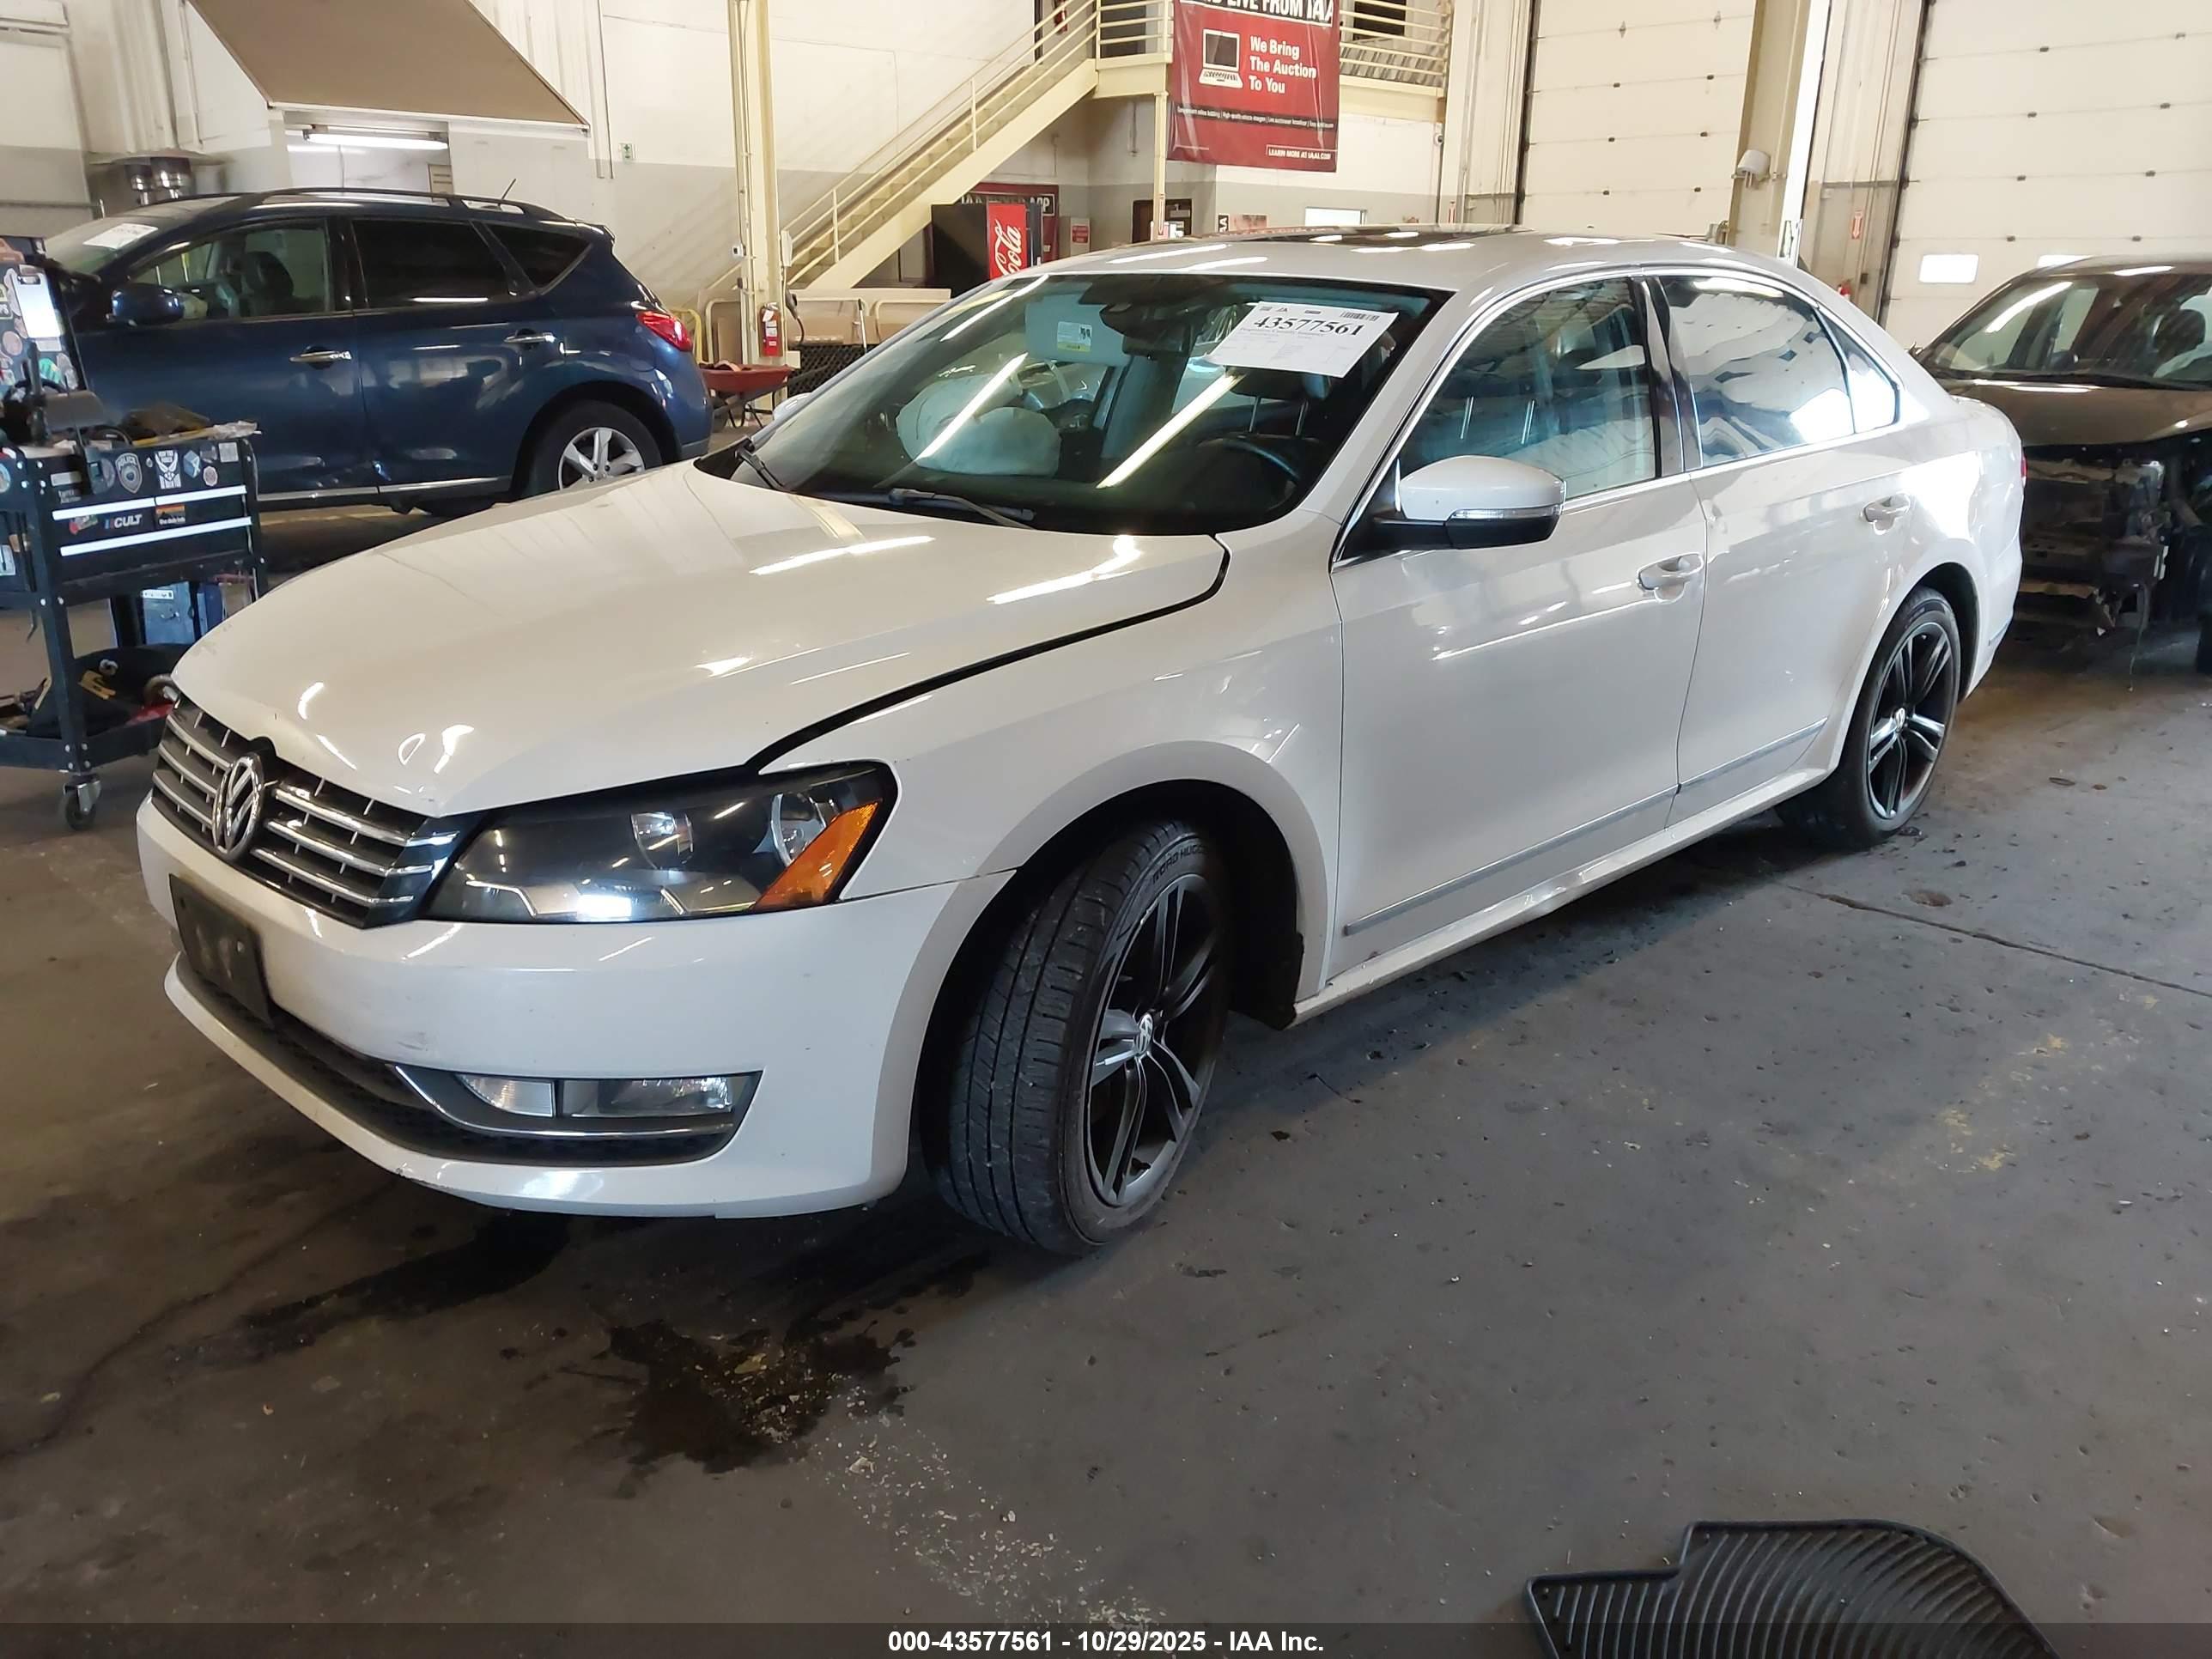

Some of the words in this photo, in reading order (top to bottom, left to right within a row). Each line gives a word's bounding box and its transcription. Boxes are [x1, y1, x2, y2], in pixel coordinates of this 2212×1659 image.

[1250, 35, 1267, 52] We
[1269, 39, 1300, 61] Bring
[1249, 55, 1270, 72] The
[1273, 59, 1317, 79] Auction
[1249, 75, 1262, 91] To
[1265, 76, 1285, 94] You
[994, 218, 1022, 276] Cola
[1254, 316, 1365, 336] 43577561
[113, 514, 143, 529] CULT
